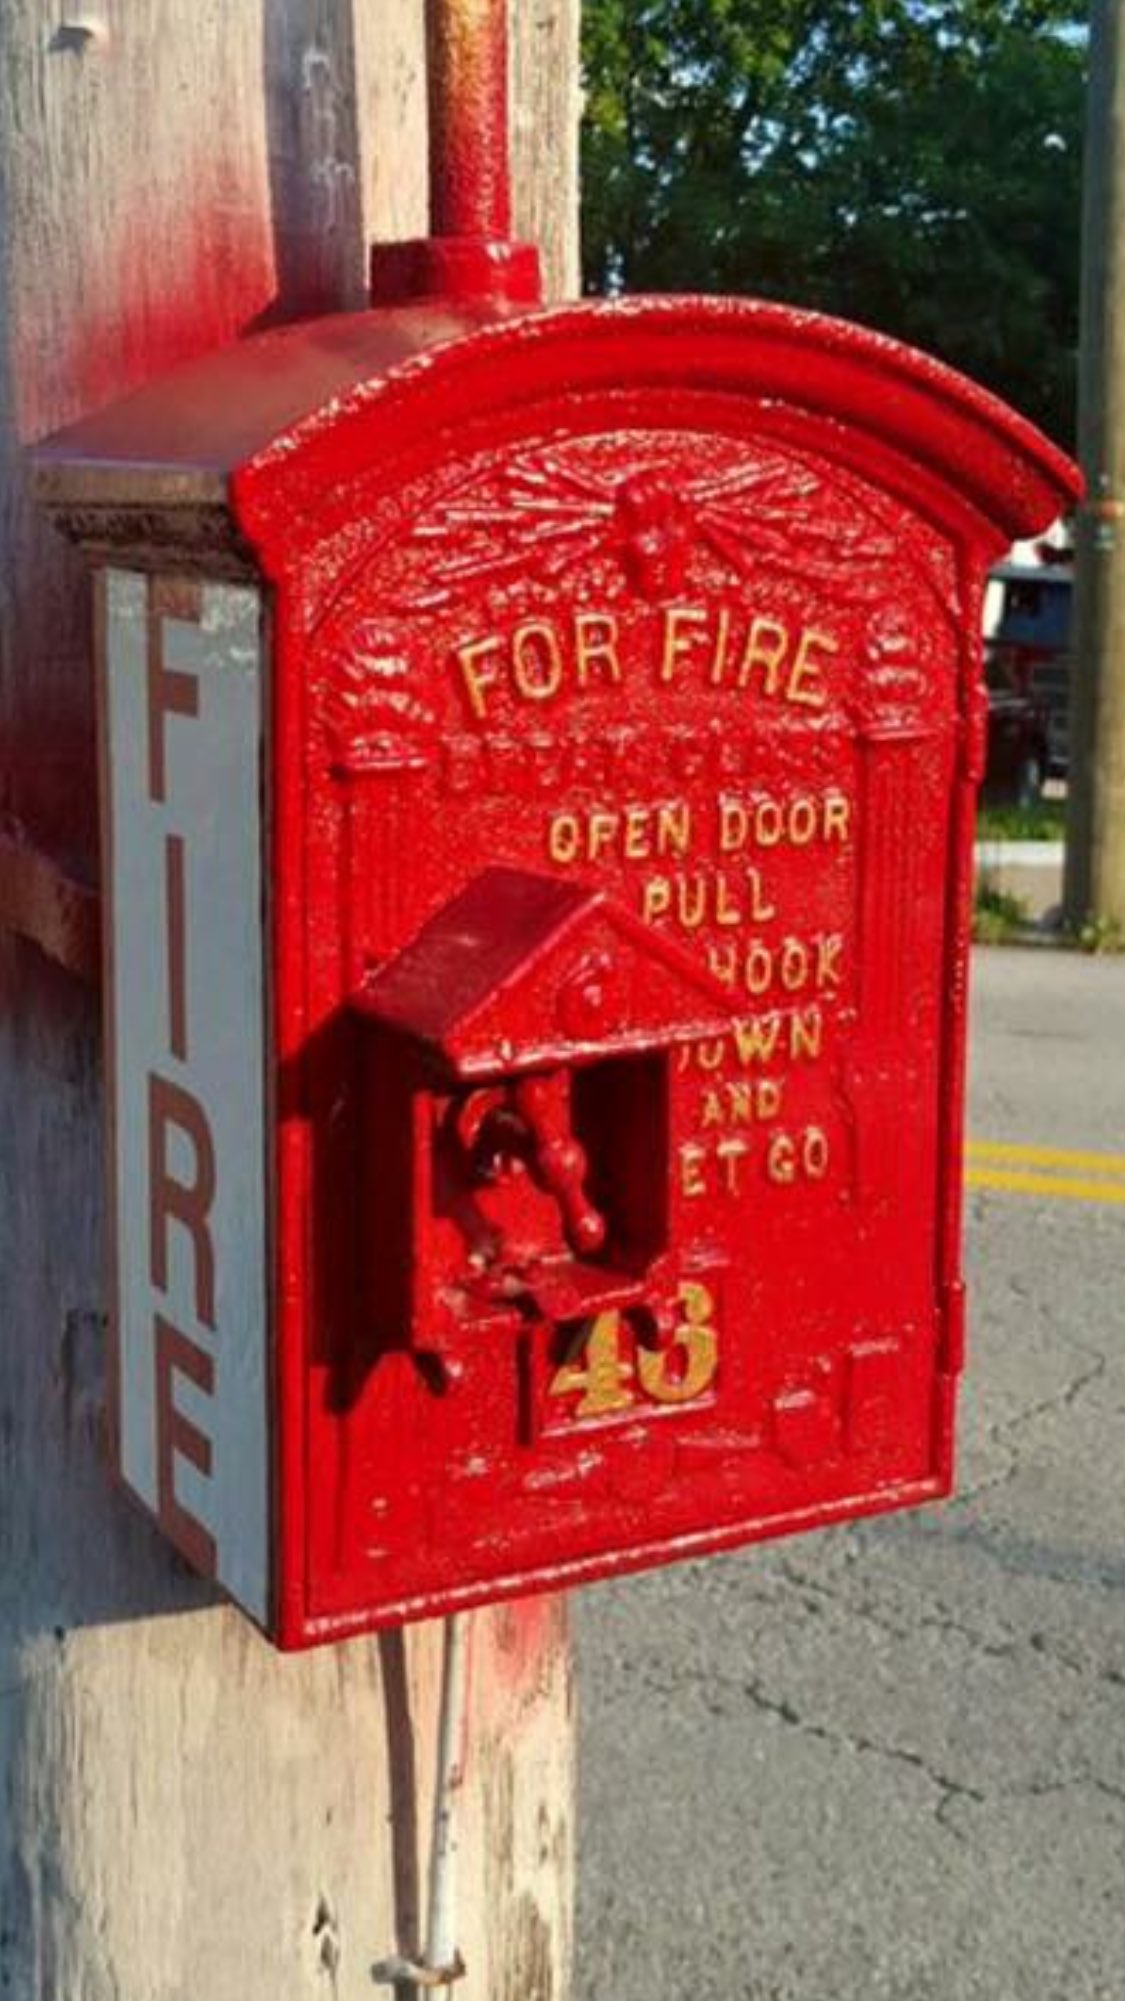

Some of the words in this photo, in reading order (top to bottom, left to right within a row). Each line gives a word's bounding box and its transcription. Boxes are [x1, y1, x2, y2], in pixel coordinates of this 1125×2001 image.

[457, 612, 622, 719] FOR
[661, 608, 839, 706] FIRE
[549, 801, 692, 862] OPEN
[718, 788, 851, 851] DOOR
[641, 867, 776, 928] PULL
[148, 577, 218, 1580] FIRE
[702, 1078, 782, 1127] AND
[680, 1141, 748, 1197] ET
[767, 1125, 830, 1182] GO
